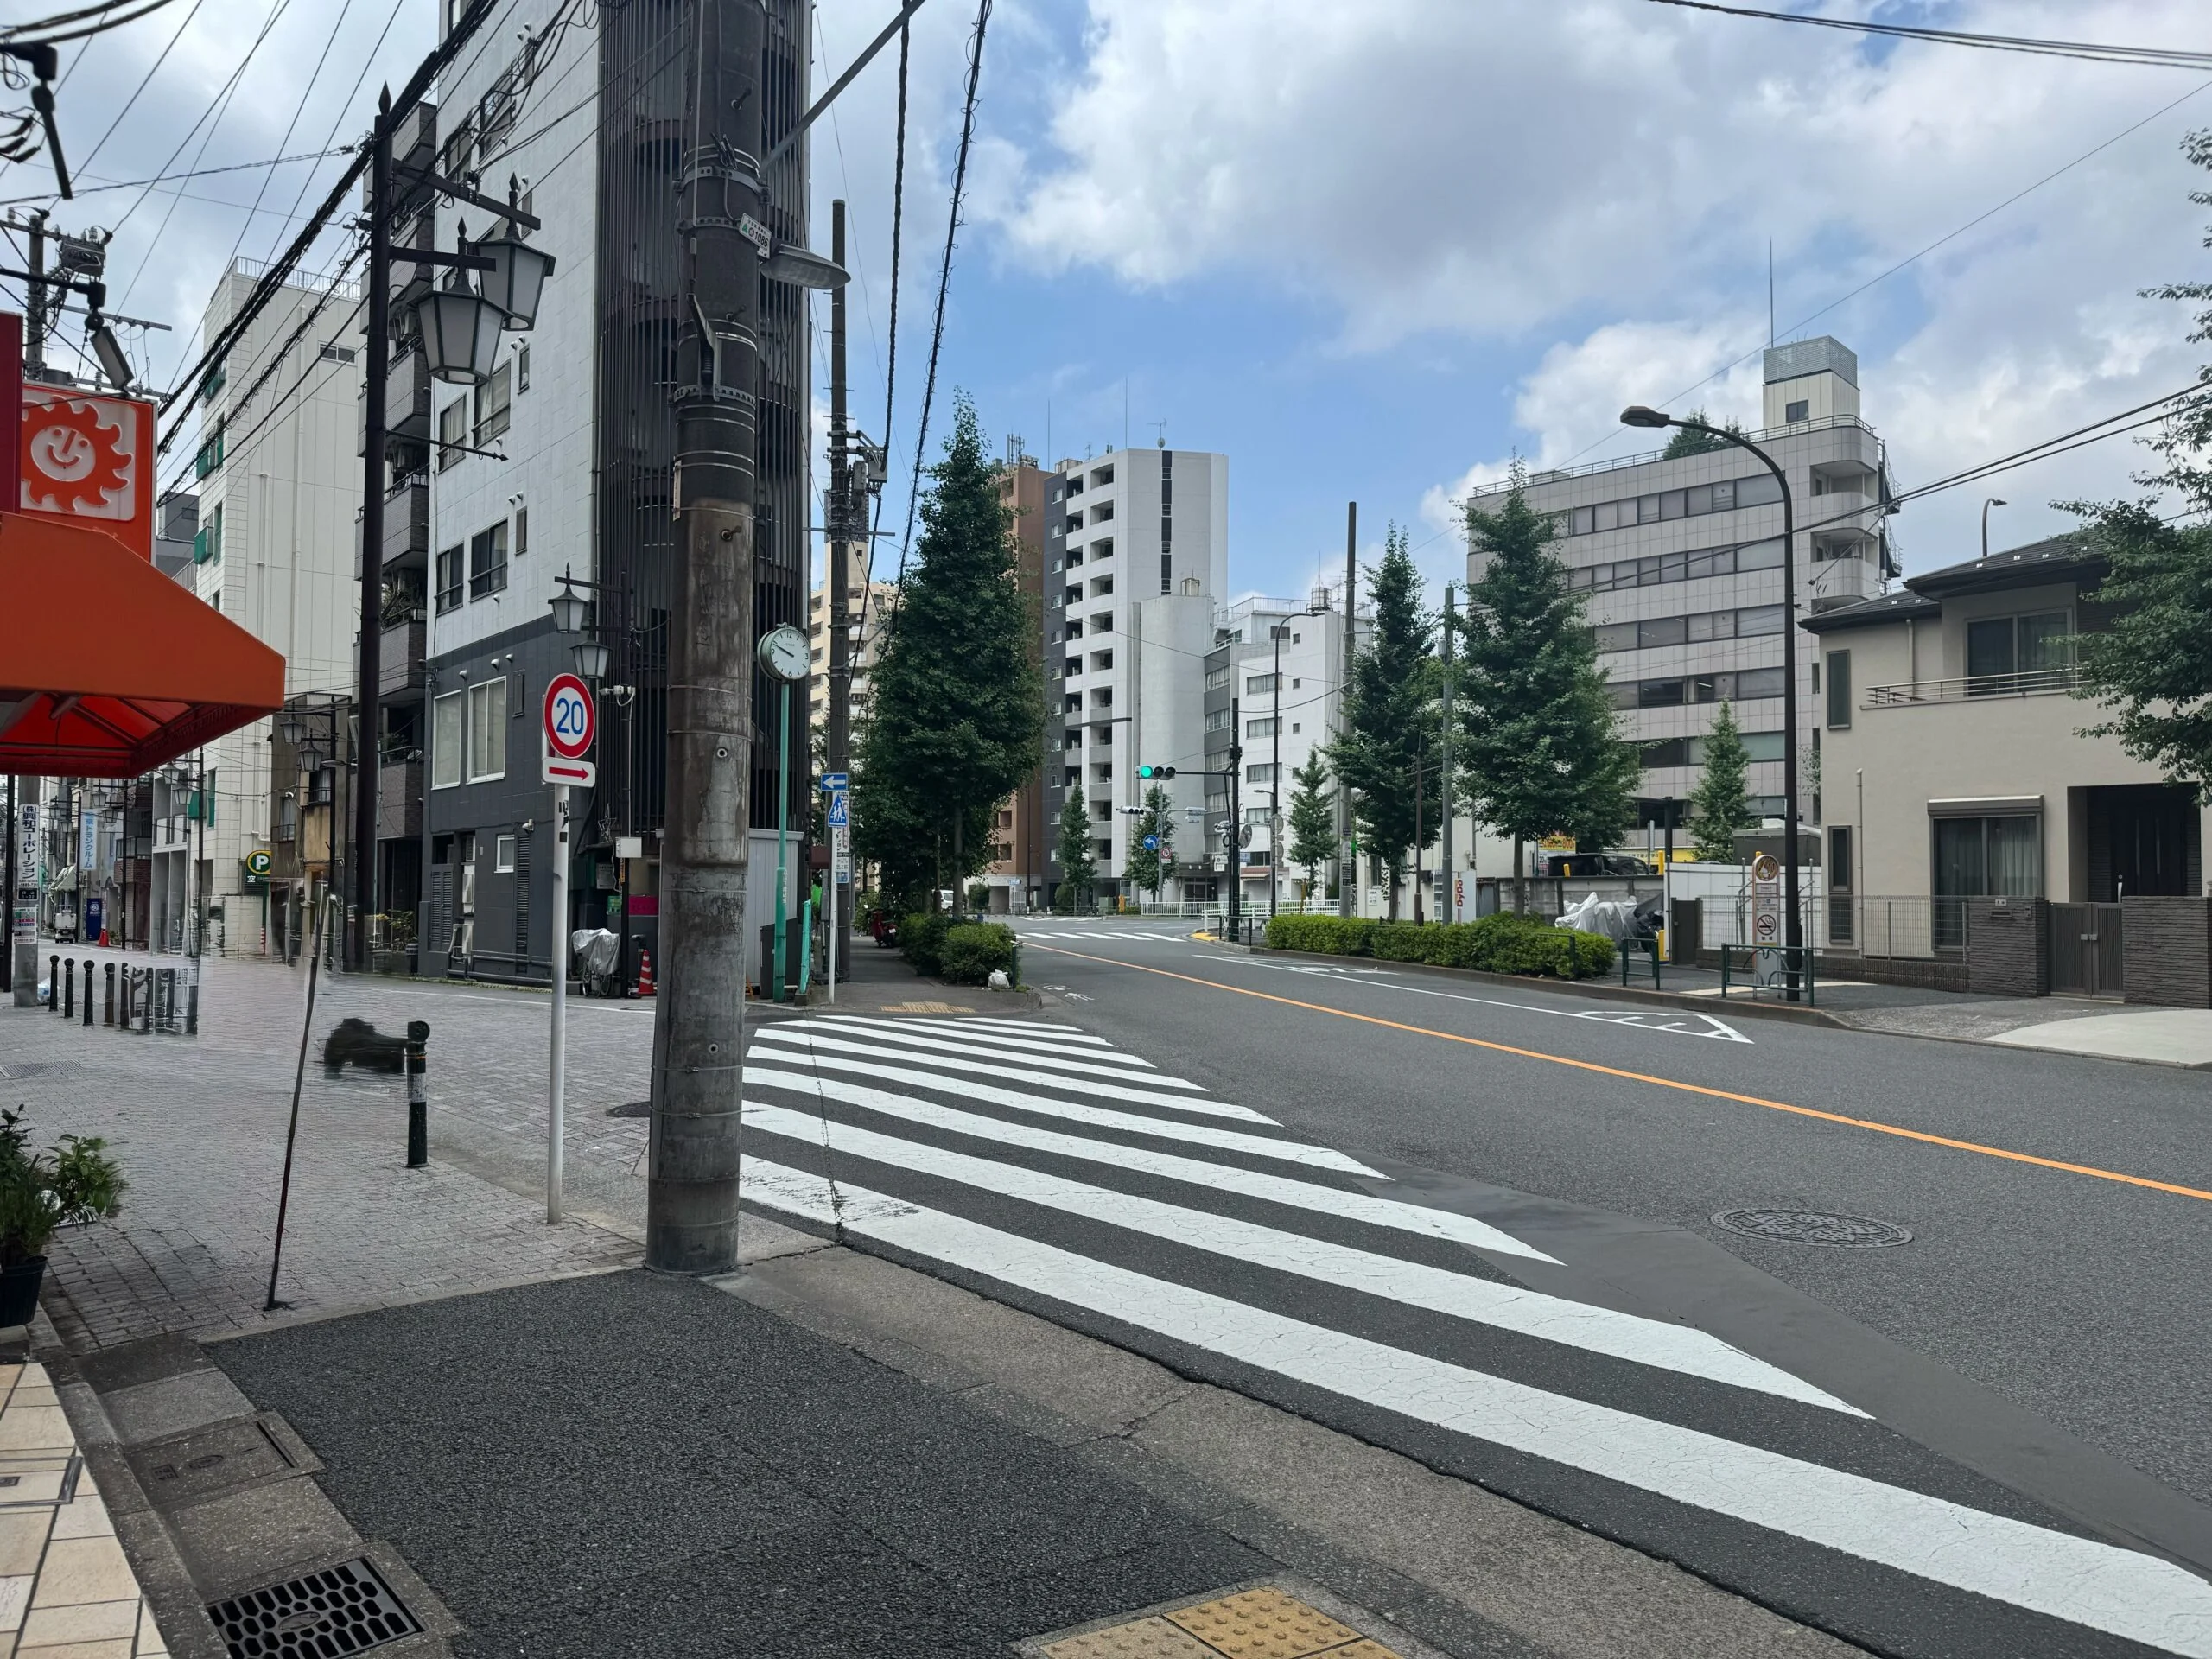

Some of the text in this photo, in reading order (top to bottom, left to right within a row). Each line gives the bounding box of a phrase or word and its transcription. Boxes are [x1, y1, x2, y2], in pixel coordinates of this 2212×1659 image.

[754, 232, 769, 248] 1086
[556, 697, 584, 735] 20
[256, 855, 269, 870] P
